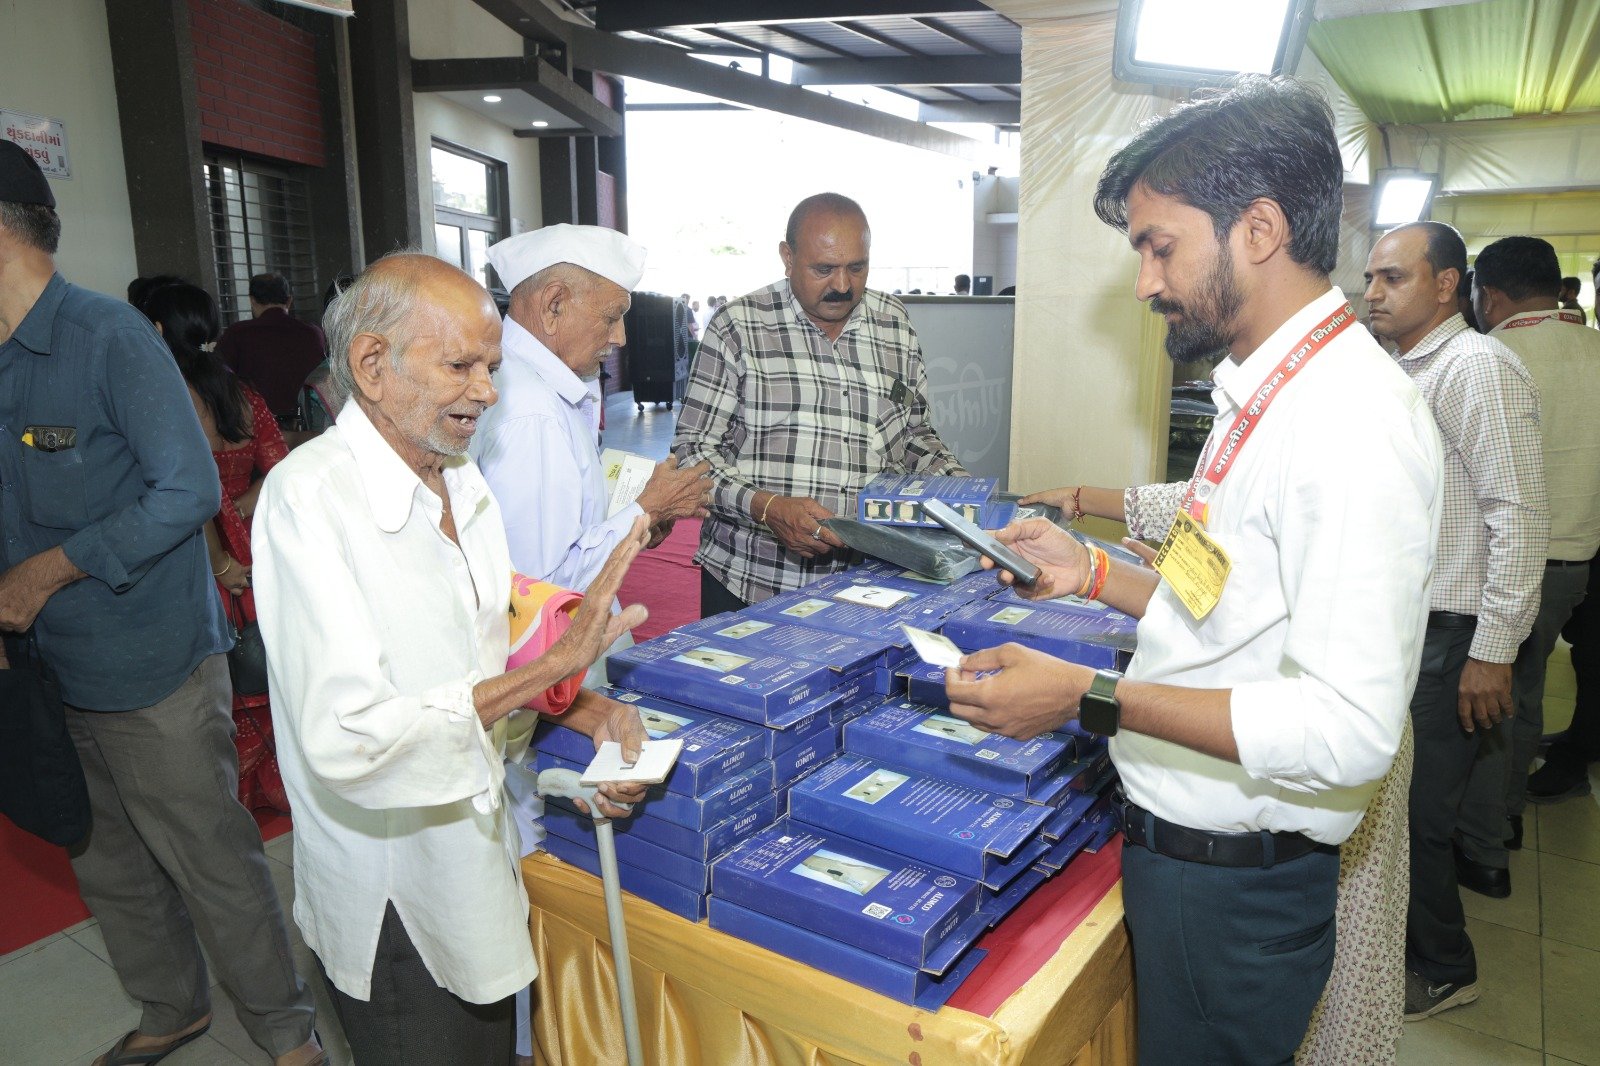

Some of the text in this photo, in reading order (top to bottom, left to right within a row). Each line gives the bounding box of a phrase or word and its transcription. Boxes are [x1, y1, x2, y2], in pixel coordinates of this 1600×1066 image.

[1215, 416, 1250, 474] भारतीय
[1286, 342, 1312, 371] अंग
[722, 751, 745, 769] ALIMCO
[728, 783, 753, 801] ALIMCO
[733, 813, 757, 832] ALIMCO
[921, 891, 945, 911] ALIMCO
